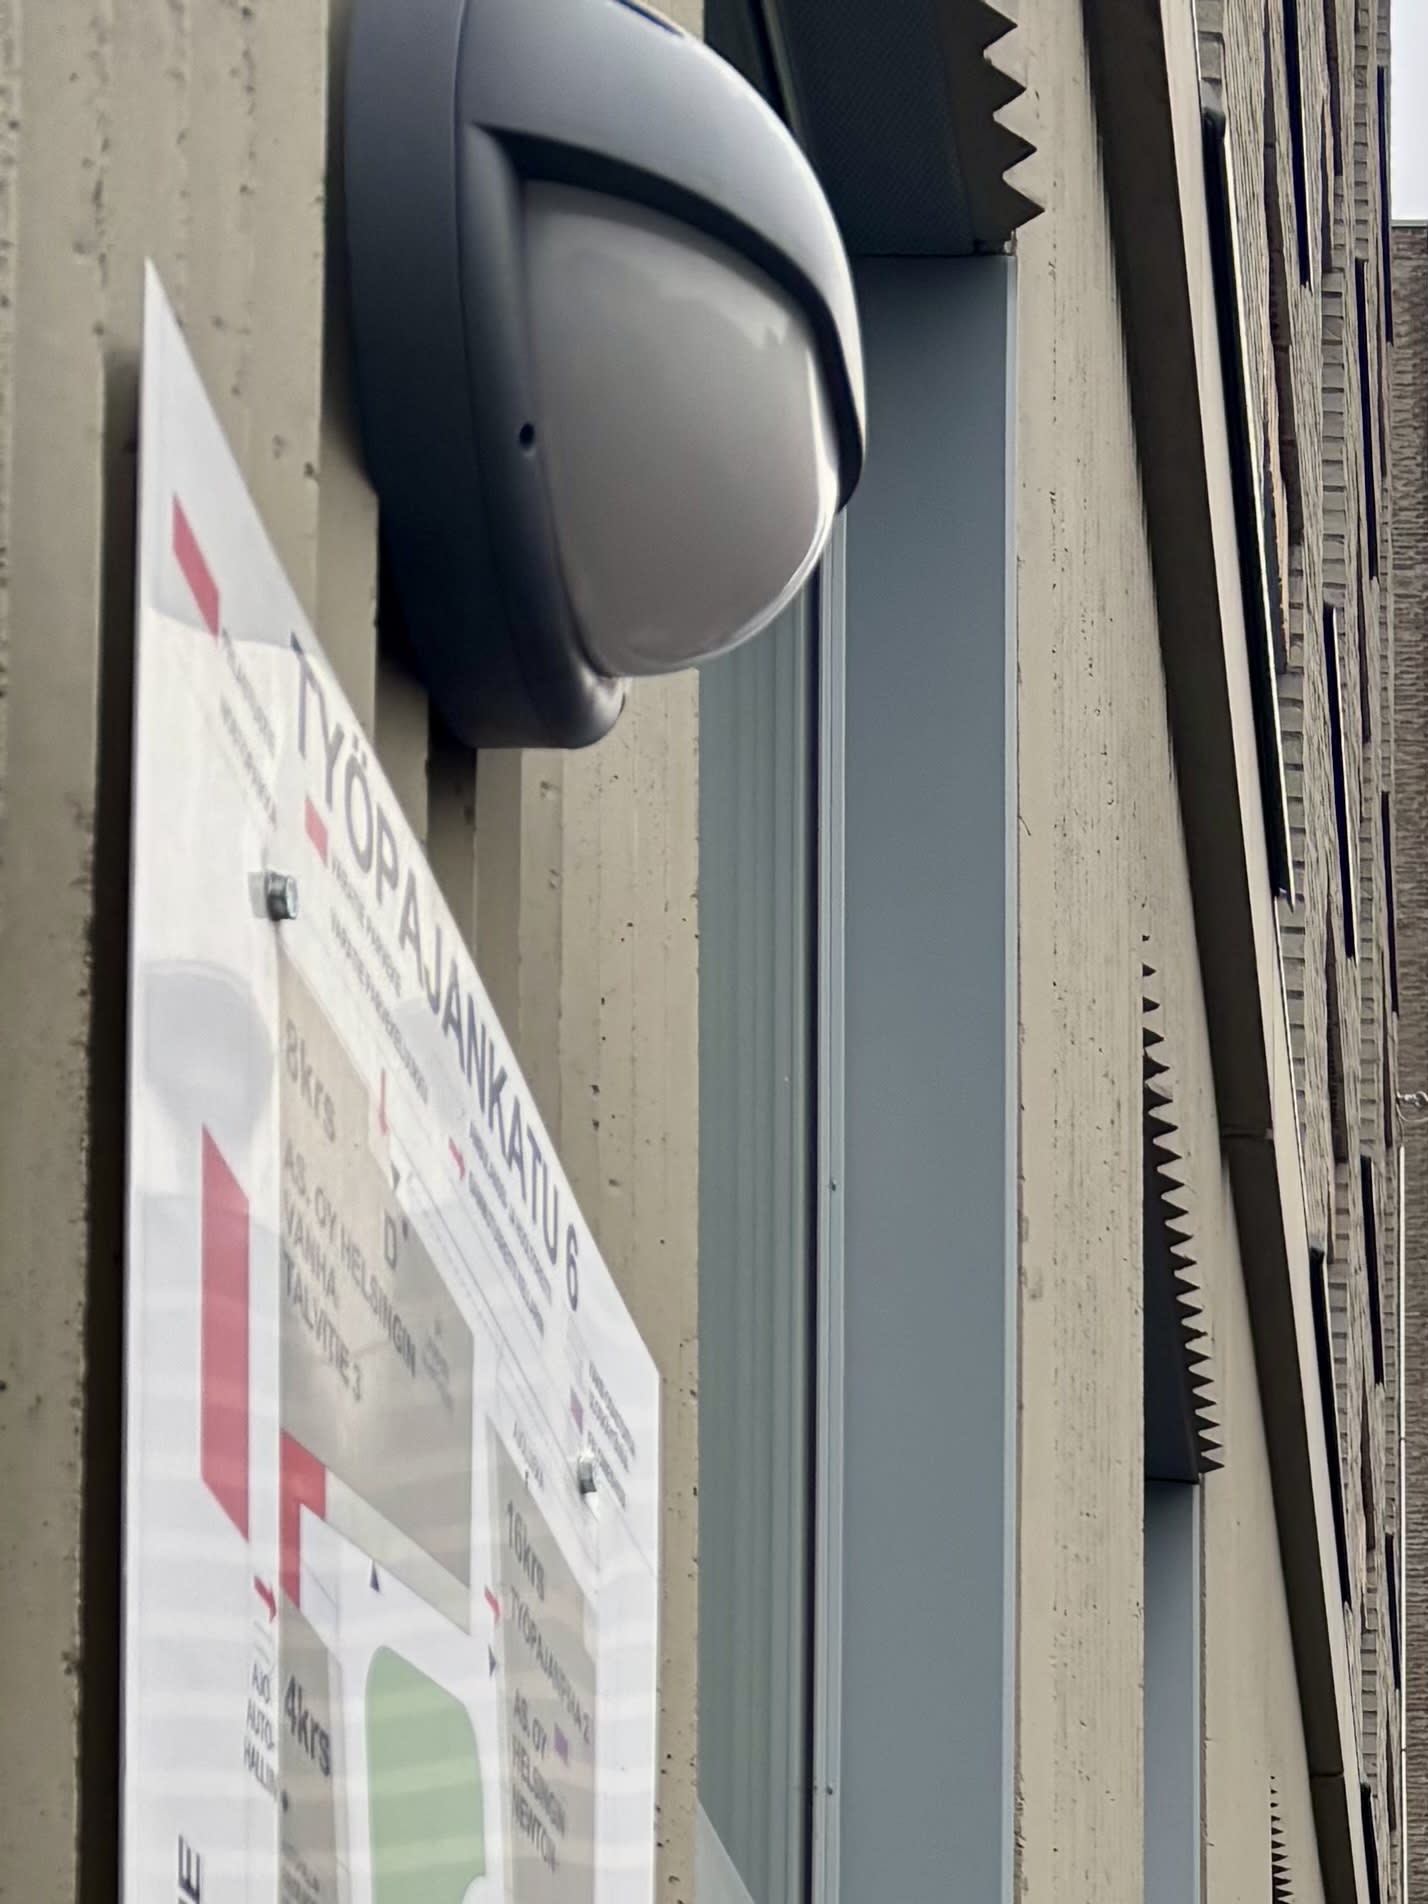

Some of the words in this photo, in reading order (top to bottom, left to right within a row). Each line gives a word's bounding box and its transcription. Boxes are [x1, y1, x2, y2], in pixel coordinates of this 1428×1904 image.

[290, 632, 558, 1266] TYÖPAJANKATU
[565, 1224, 580, 1312] 6
[283, 1186, 336, 1313] VANHA
[283, 1246, 349, 1392] TALVITIE
[340, 1218, 416, 1385] HELSINGIN
[284, 1666, 329, 1781] 4krs
